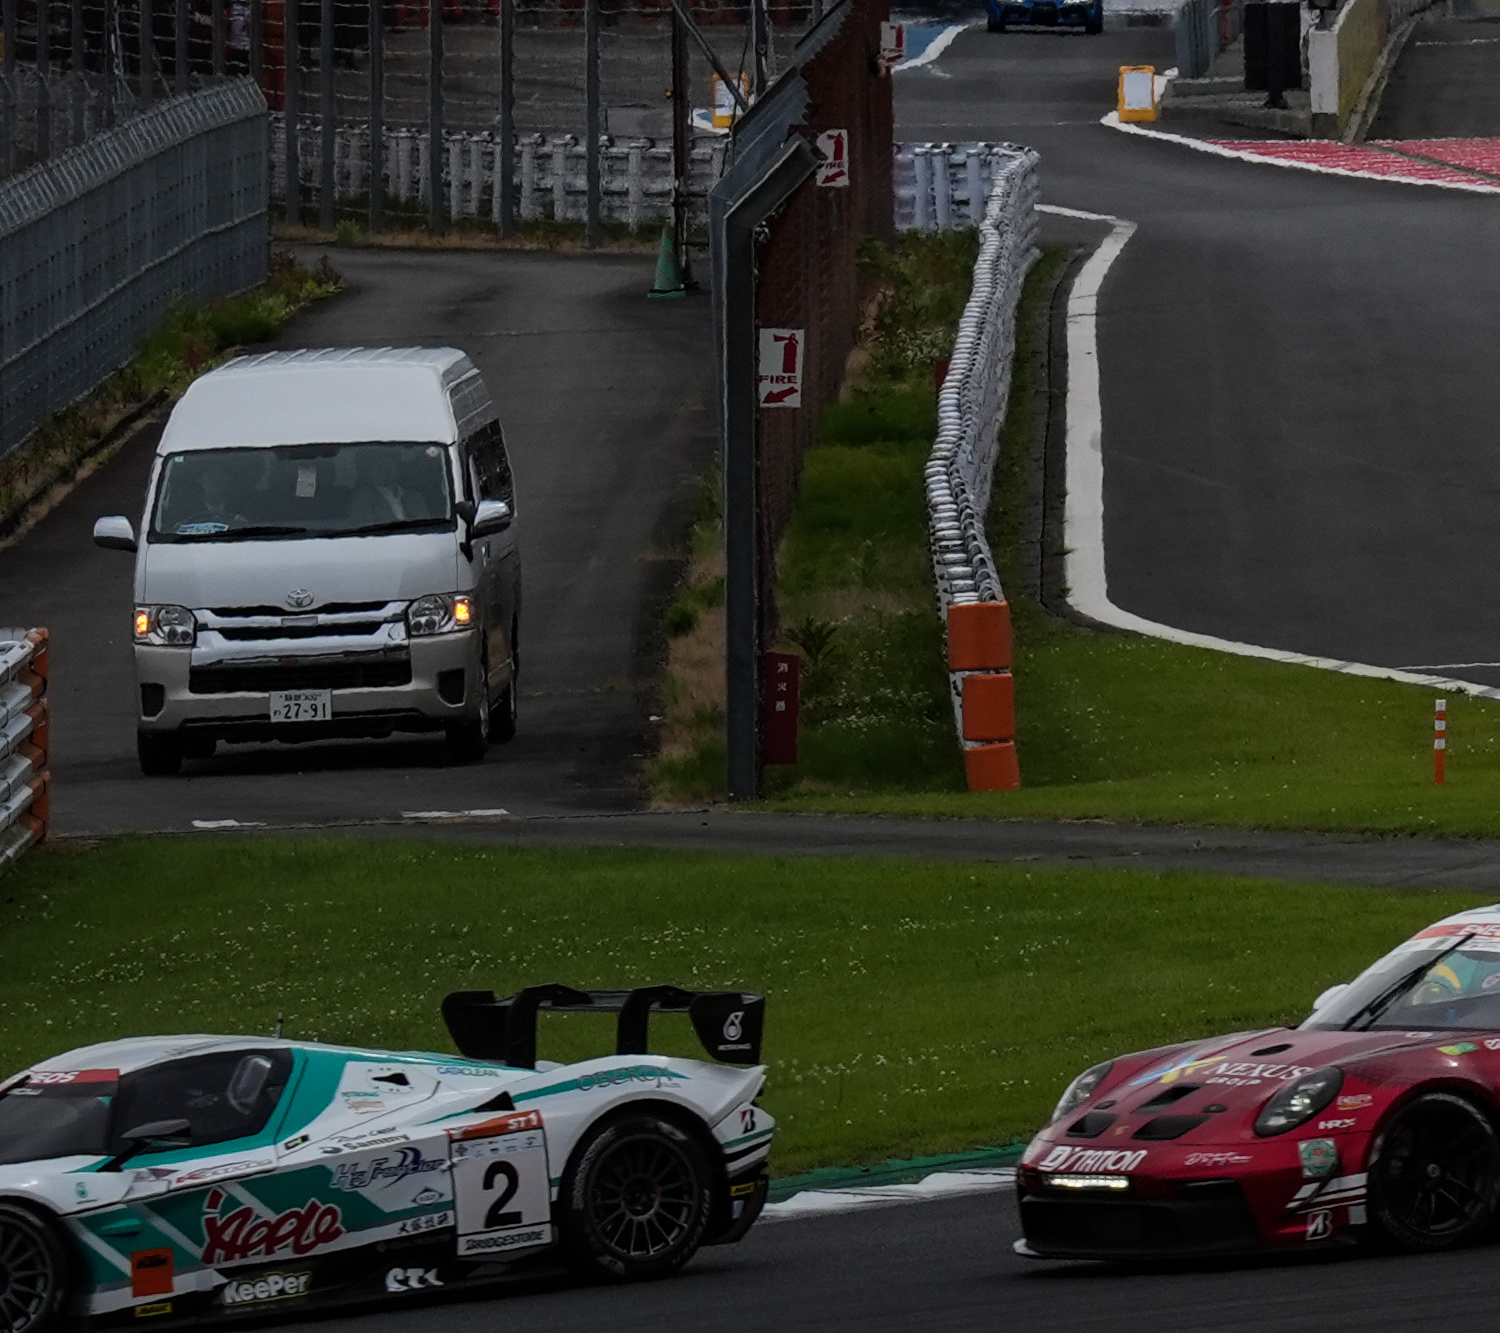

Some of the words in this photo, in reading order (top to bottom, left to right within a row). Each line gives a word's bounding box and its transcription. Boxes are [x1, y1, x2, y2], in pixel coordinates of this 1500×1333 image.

[757, 374, 799, 384] FIRE
[283, 702, 327, 720] 27-91
[1202, 1061, 1316, 1081] NEXUS
[507, 1111, 539, 1130] ST1
[342, 1132, 411, 1151] Sammy
[1037, 1145, 1149, 1172] D'STATION
[482, 1160, 523, 1229] 2
[223, 1270, 313, 1305] KeePer
